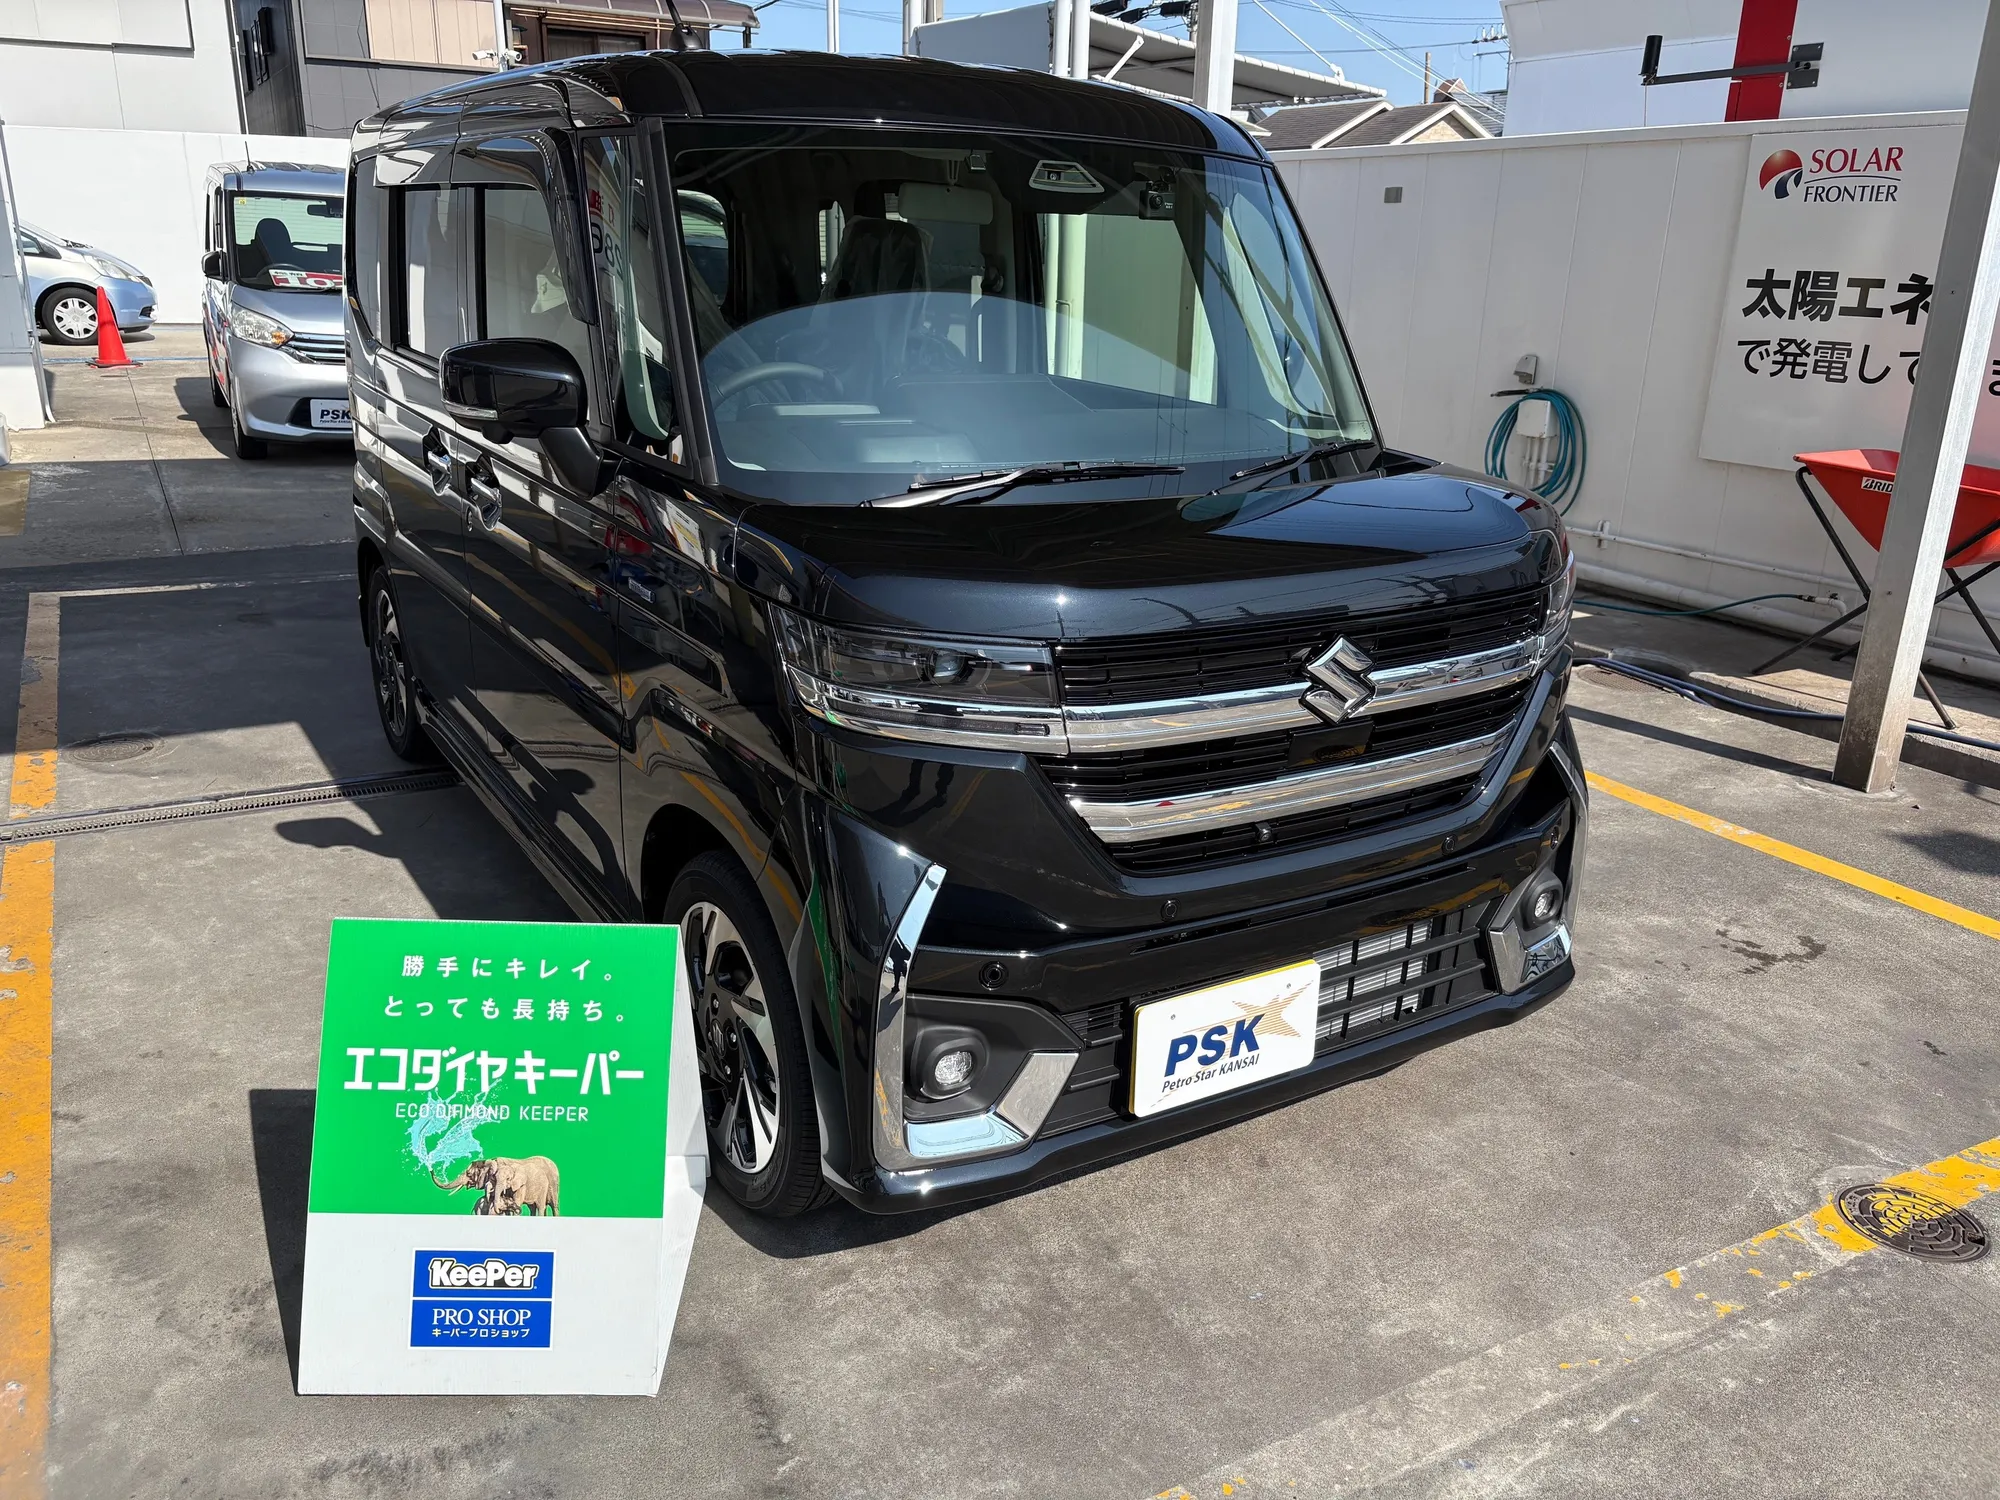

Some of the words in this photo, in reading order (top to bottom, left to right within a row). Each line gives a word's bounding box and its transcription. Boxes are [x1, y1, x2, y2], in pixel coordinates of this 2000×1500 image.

[1809, 146, 1904, 174] SOLAR
[1803, 184, 1898, 203] FRONTIER
[320, 409, 352, 420] PSK
[401, 955, 612, 982] 勝手にキレイ。
[383, 995, 624, 1023] とっても長持ち。
[1164, 1013, 1266, 1078] PSK
[343, 1046, 645, 1095] エコダイヤキーパー
[1161, 1075, 1193, 1093] Petro
[1194, 1068, 1217, 1084] Star
[1218, 1053, 1260, 1076] KANSAI
[395, 1103, 430, 1118] ECO
[436, 1104, 510, 1120] DIAMOND
[519, 1106, 589, 1122] KEEPER
[429, 1258, 539, 1289] KeePer
[432, 1308, 473, 1326] PRO
[477, 1308, 531, 1326] SHOP
[431, 1328, 530, 1338] キーパープロショップ
